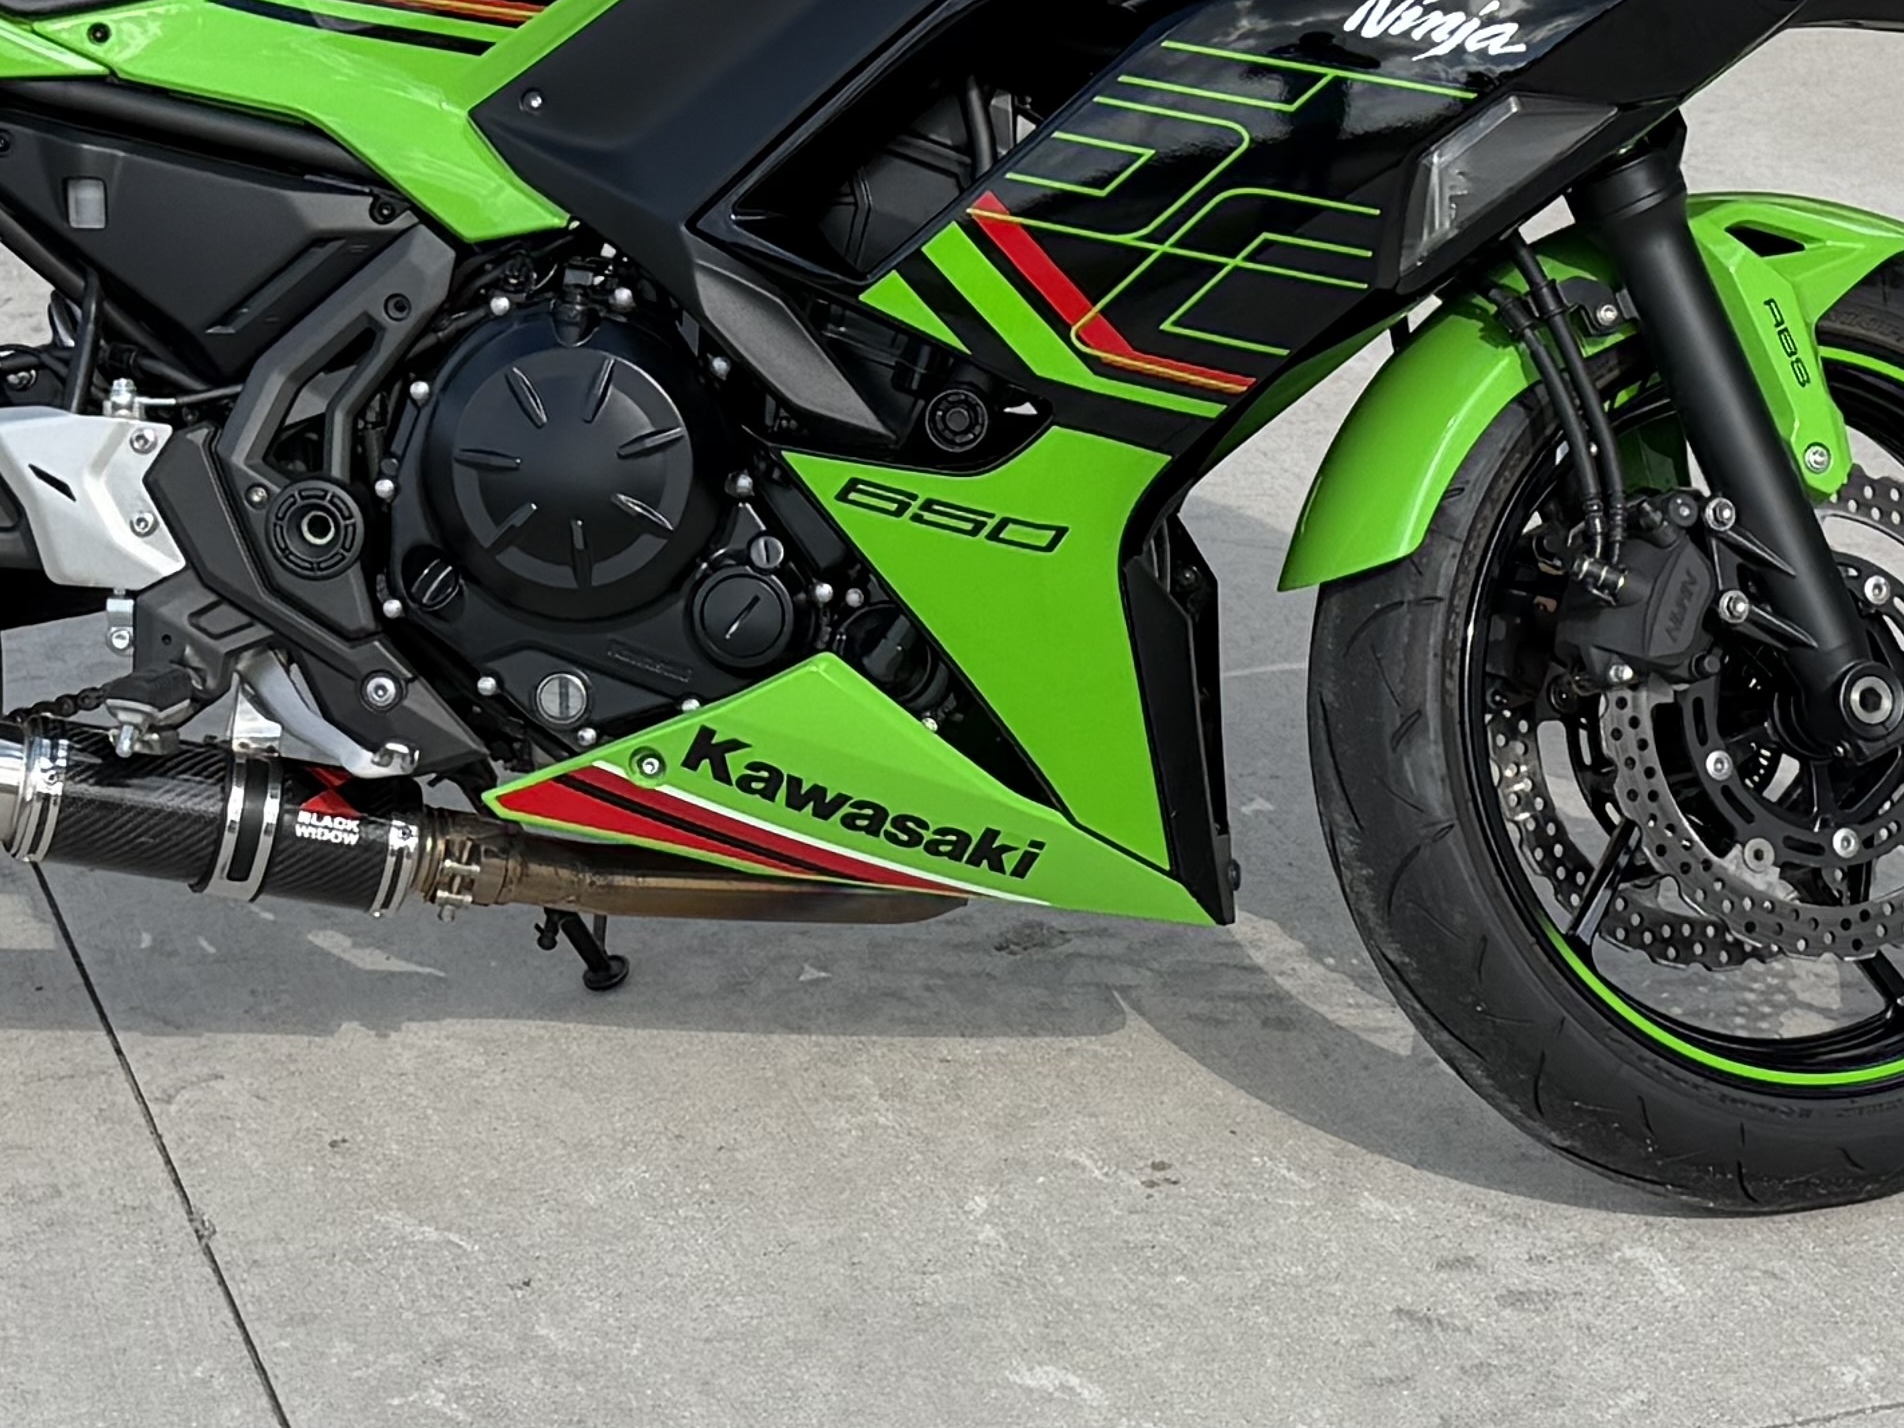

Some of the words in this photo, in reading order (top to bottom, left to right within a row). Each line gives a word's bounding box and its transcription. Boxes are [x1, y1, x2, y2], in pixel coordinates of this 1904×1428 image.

[833, 475, 1070, 554] 650
[296, 810, 360, 833] BLACK
[679, 725, 1046, 881] Kawasaki
[295, 823, 360, 846] WIDOW
